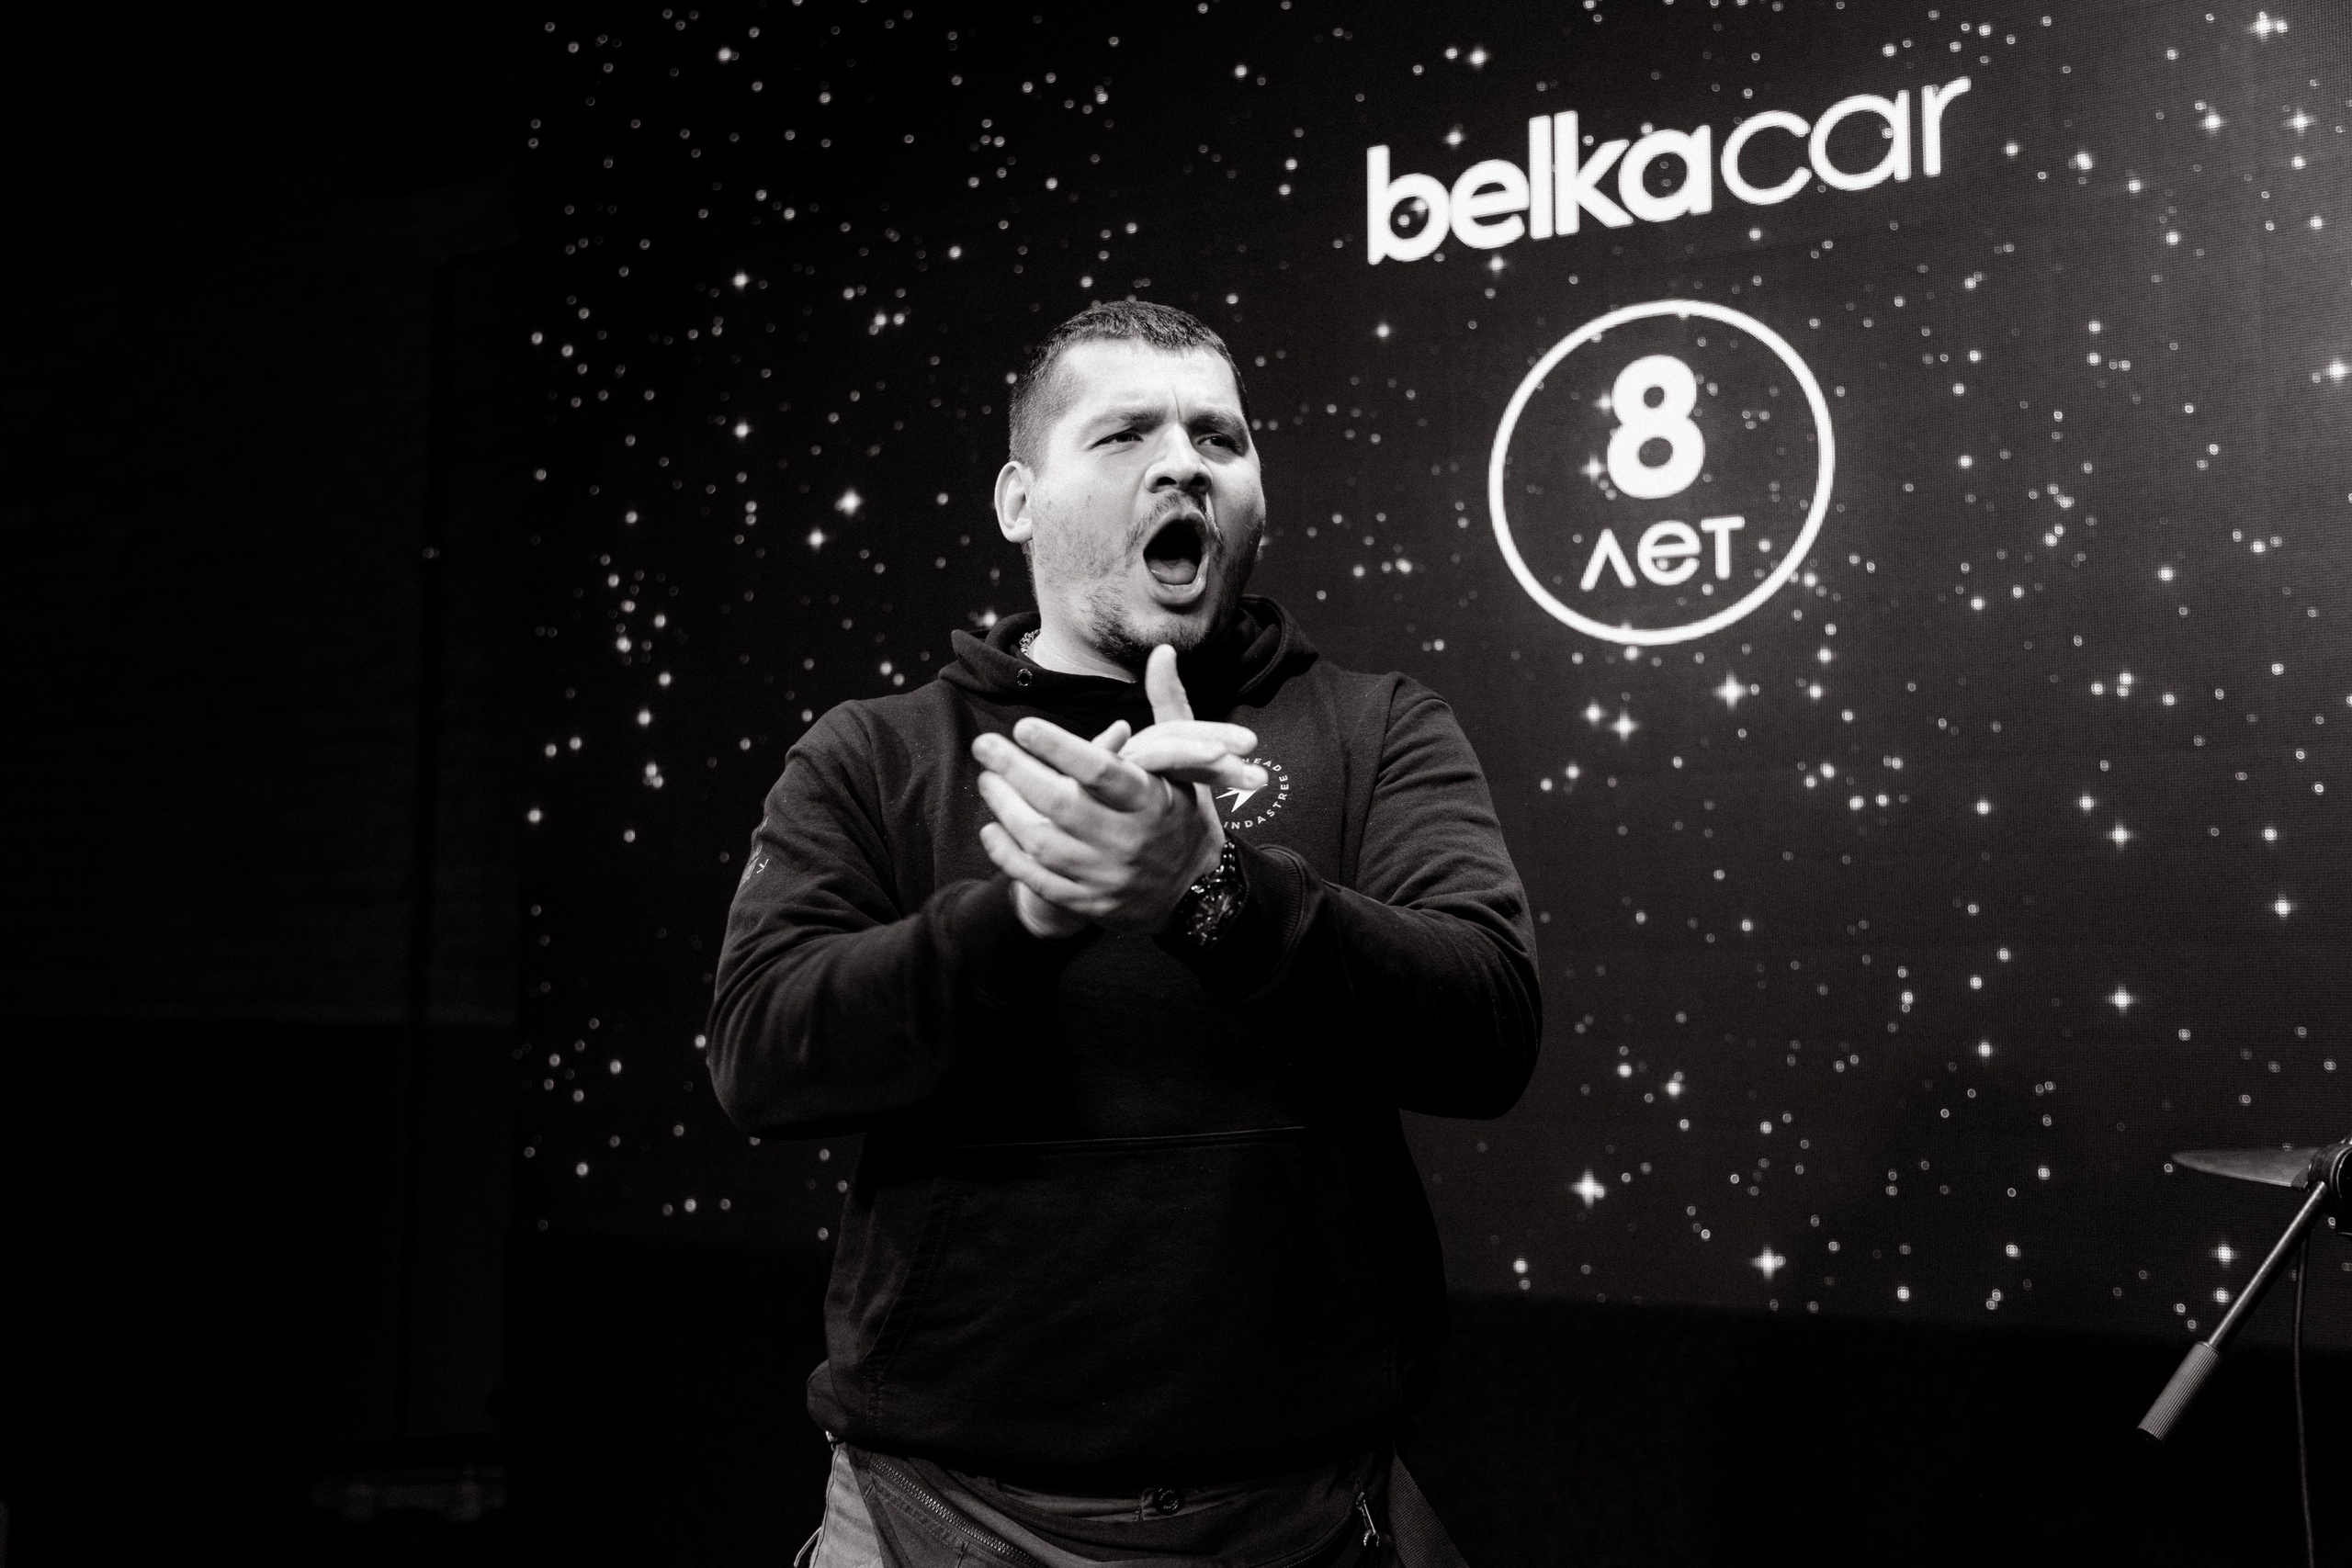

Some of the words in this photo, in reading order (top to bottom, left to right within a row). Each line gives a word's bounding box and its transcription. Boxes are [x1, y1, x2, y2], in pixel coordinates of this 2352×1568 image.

[1366, 76, 1972, 265] belkacar
[1607, 355, 1706, 500] 8
[1580, 516, 1746, 591] лет
